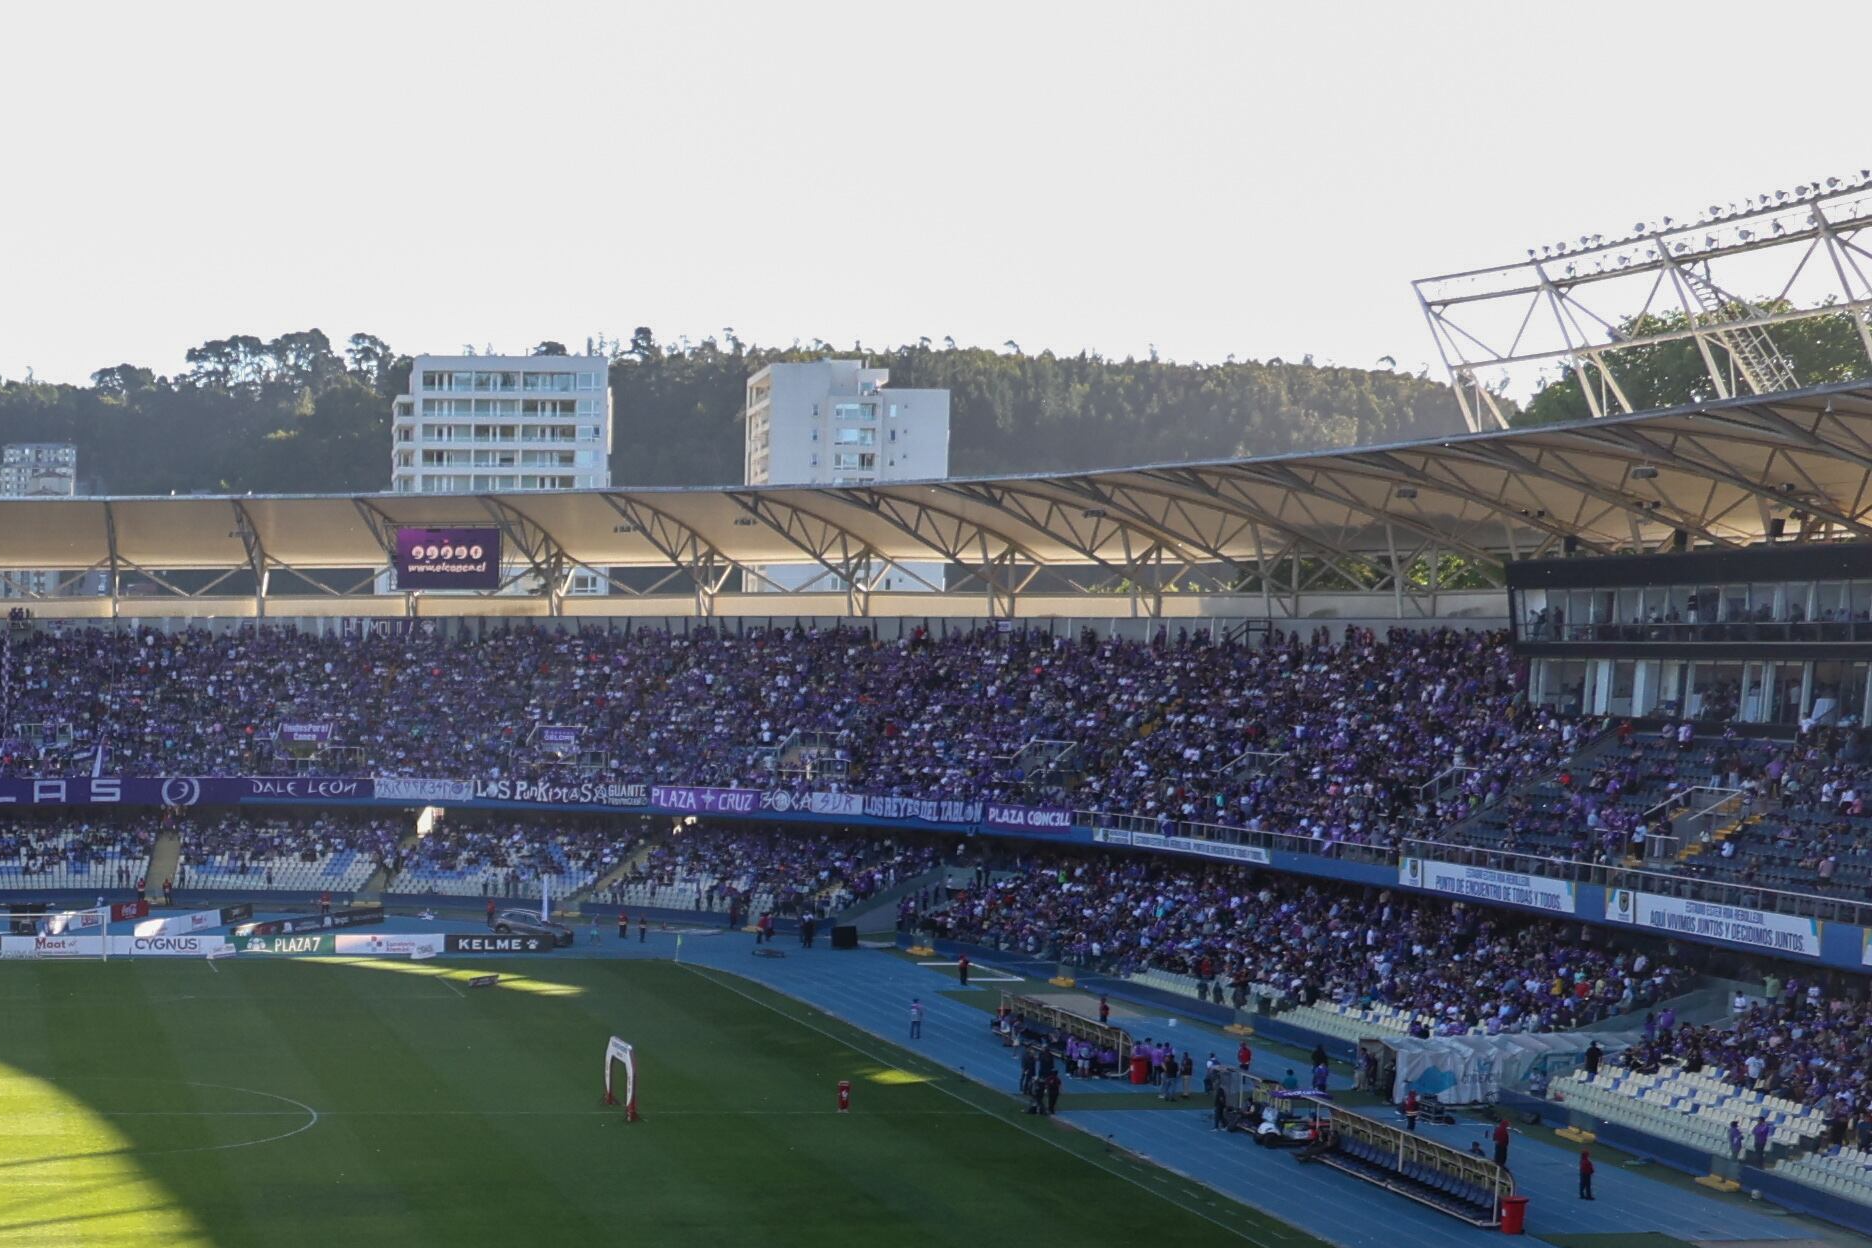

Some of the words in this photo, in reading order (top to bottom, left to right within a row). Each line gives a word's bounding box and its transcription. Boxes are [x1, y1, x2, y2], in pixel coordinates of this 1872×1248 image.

[252, 780, 297, 798] DALE
[307, 780, 358, 798] LEON
[651, 788, 697, 810] PLAZA
[718, 793, 753, 811] CRUZ
[988, 808, 1024, 825] PLAZA
[135, 938, 198, 951] CYGNUS
[458, 939, 522, 950] KELME
